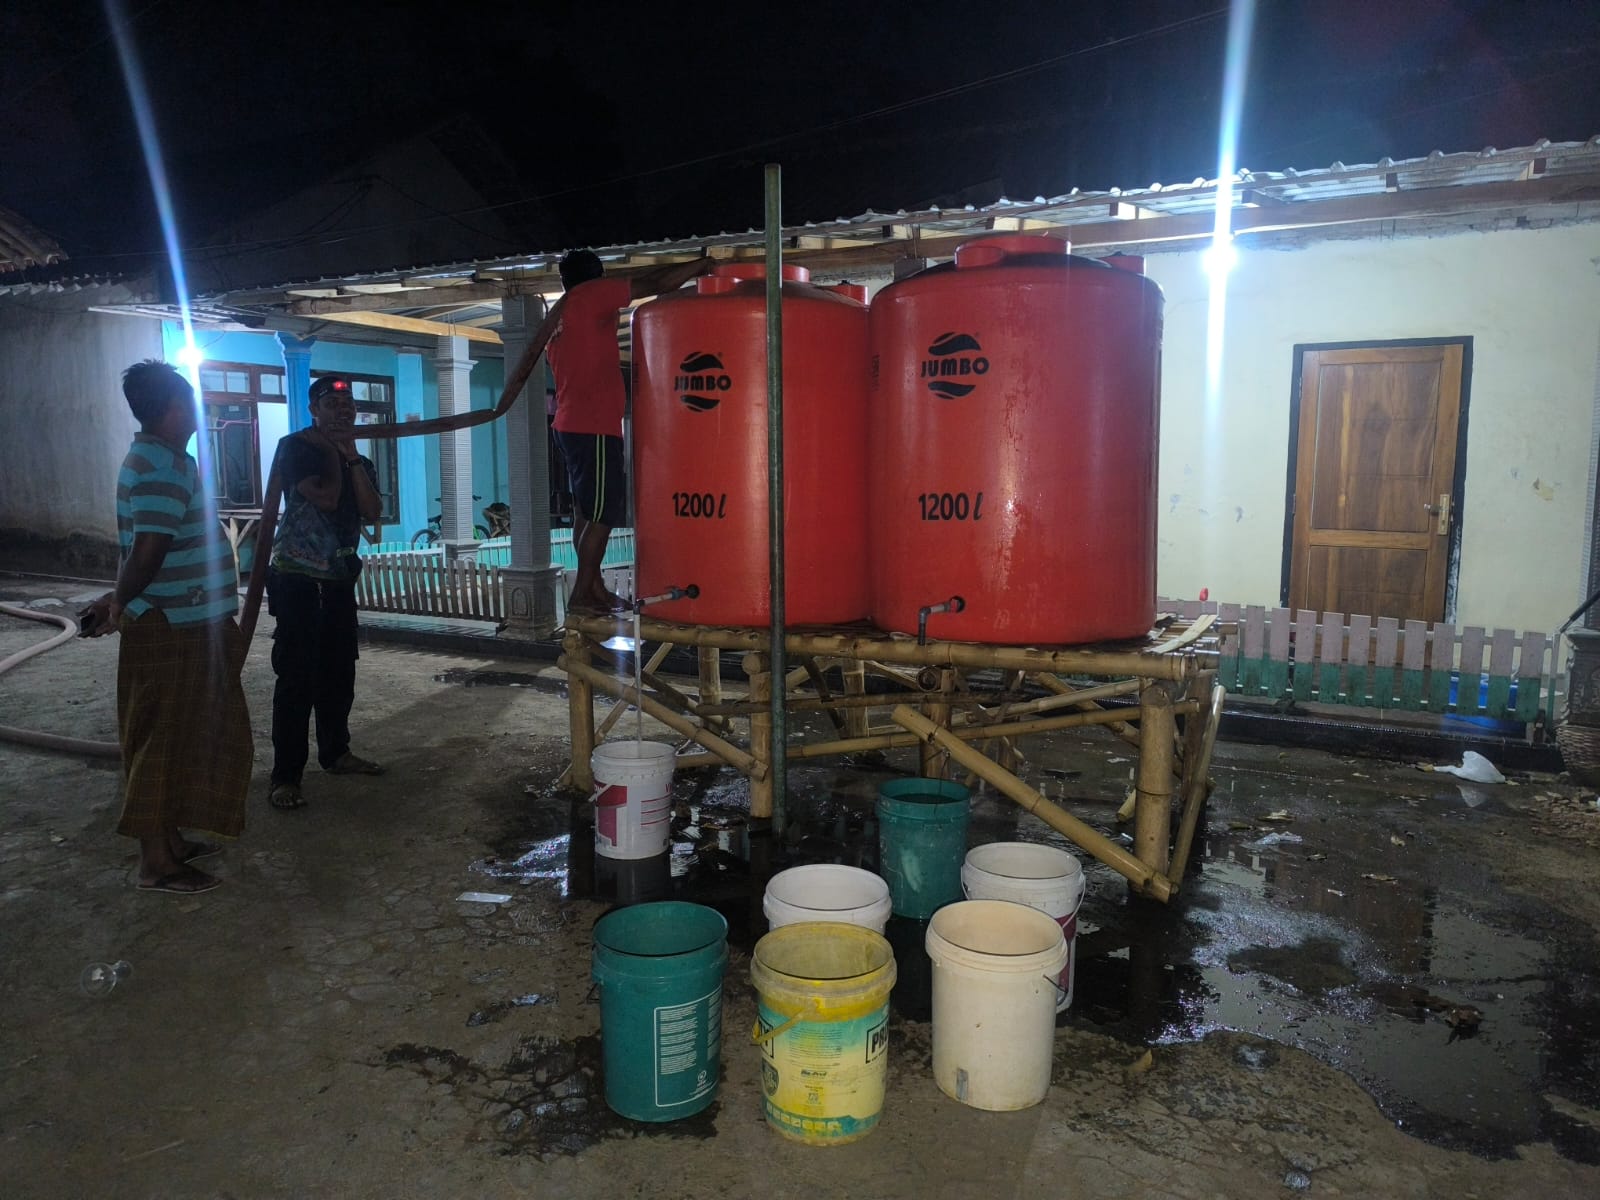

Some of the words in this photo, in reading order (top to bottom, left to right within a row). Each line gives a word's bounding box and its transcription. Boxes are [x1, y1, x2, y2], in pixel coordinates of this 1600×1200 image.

[920, 356, 990, 377] JUMBO
[673, 374, 732, 391] JUMBO
[672, 492, 715, 518] 1200
[918, 492, 970, 520] 1200
